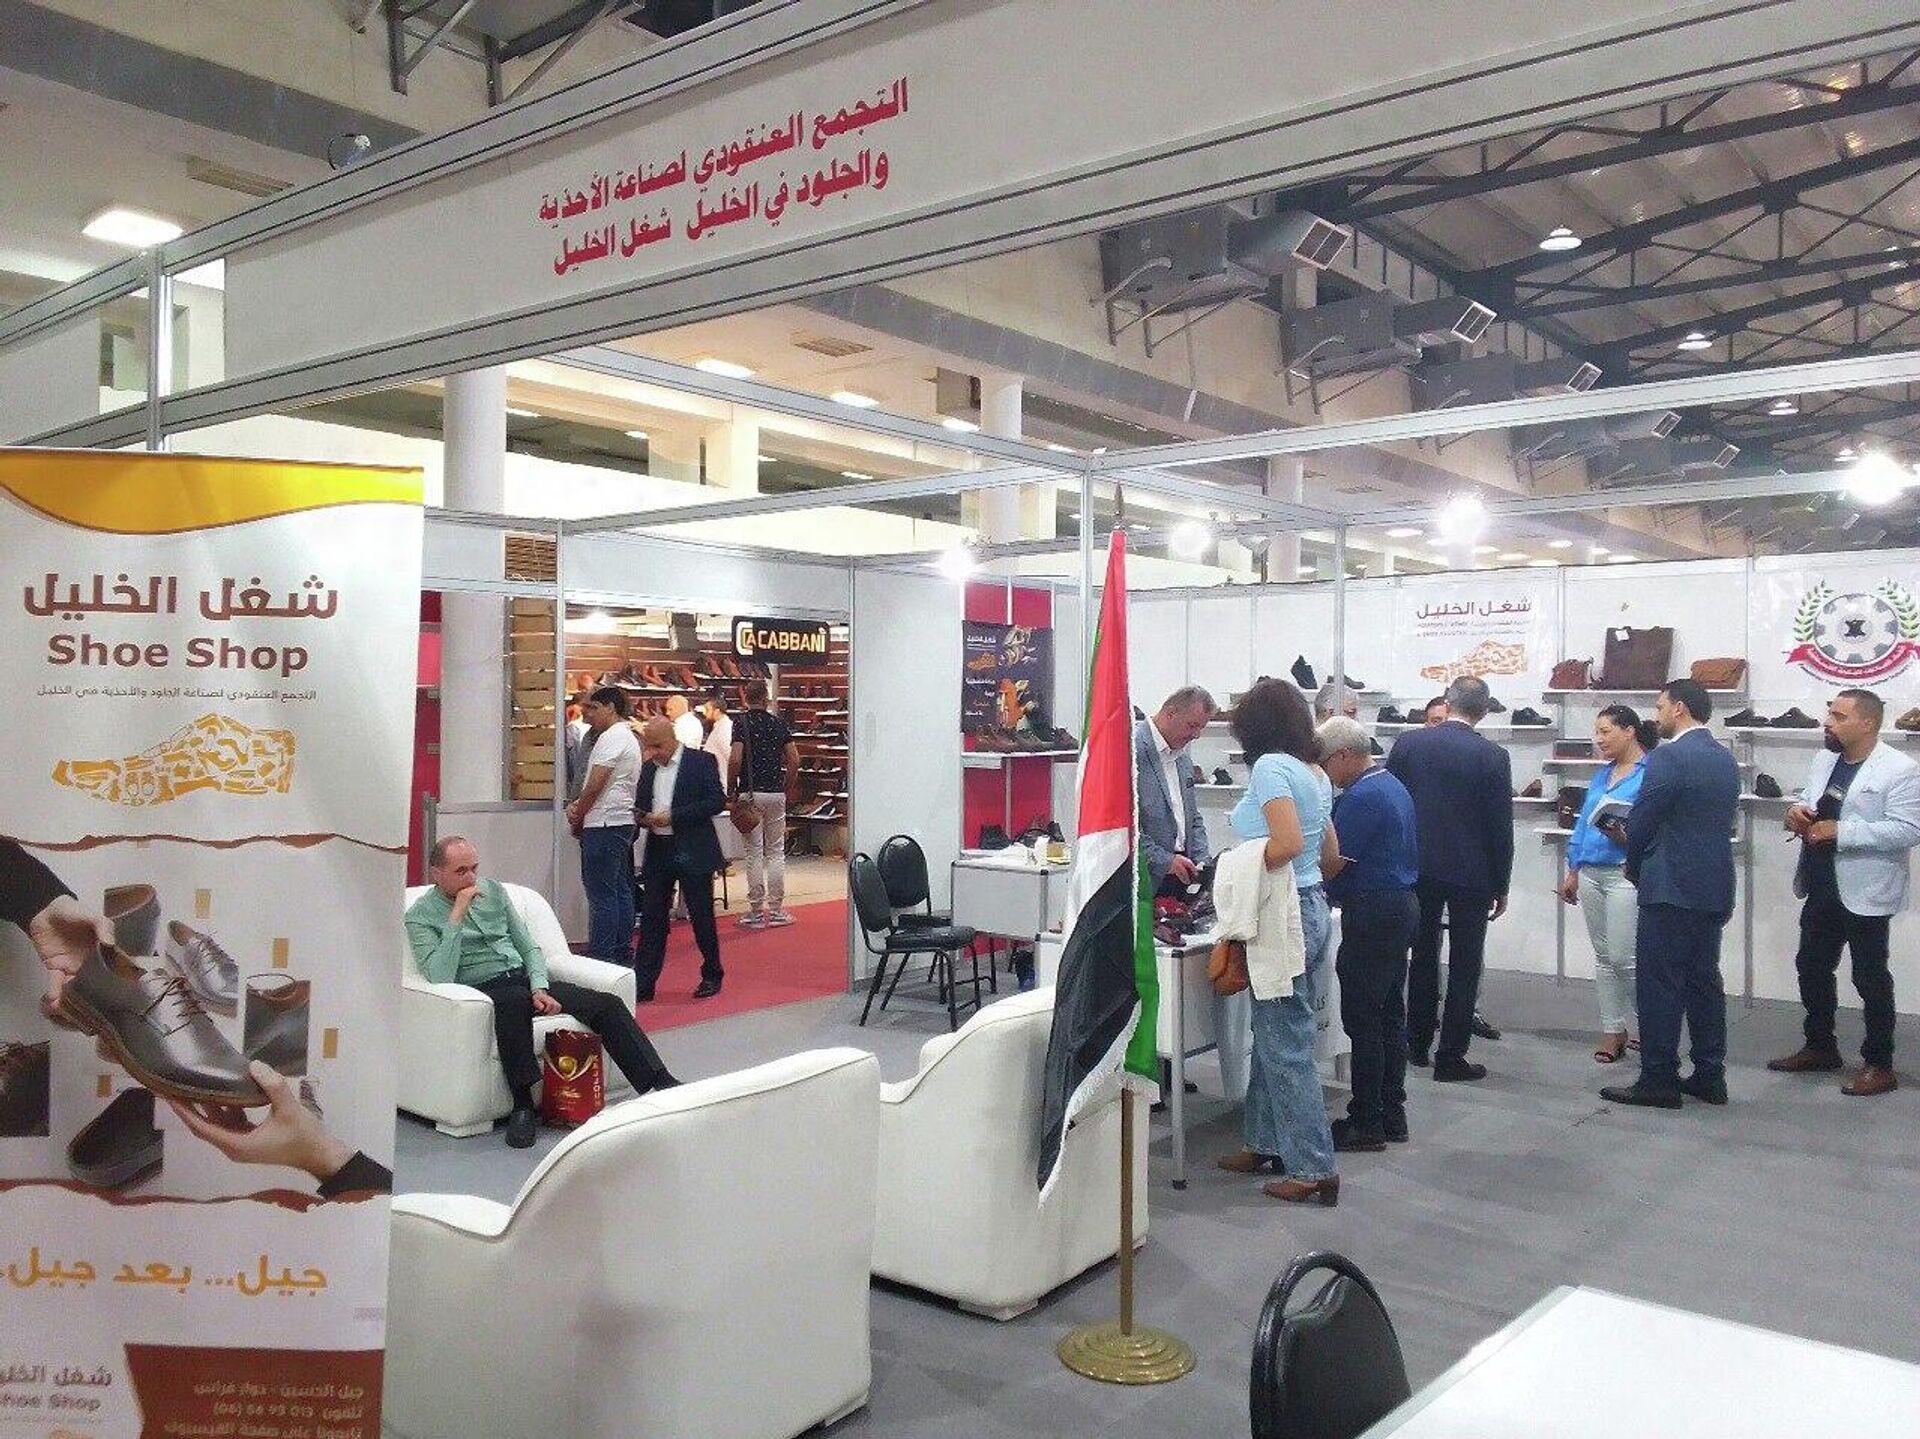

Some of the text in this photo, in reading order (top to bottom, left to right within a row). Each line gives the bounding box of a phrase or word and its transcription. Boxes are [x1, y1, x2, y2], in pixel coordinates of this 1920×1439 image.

[812, 76, 908, 150] التجمع
[538, 171, 608, 228] الأحذية
[614, 150, 686, 201] لصناعة
[553, 146, 890, 276] والجلود في الخليل شغل الخليل
[23, 572, 338, 622] شغل الخليل
[1416, 596, 1533, 620] شغل الخليل
[46, 633, 309, 678] Shoe Shop
[280, 690, 317, 704] التجمع
[113, 1261, 192, 1294] بعد
